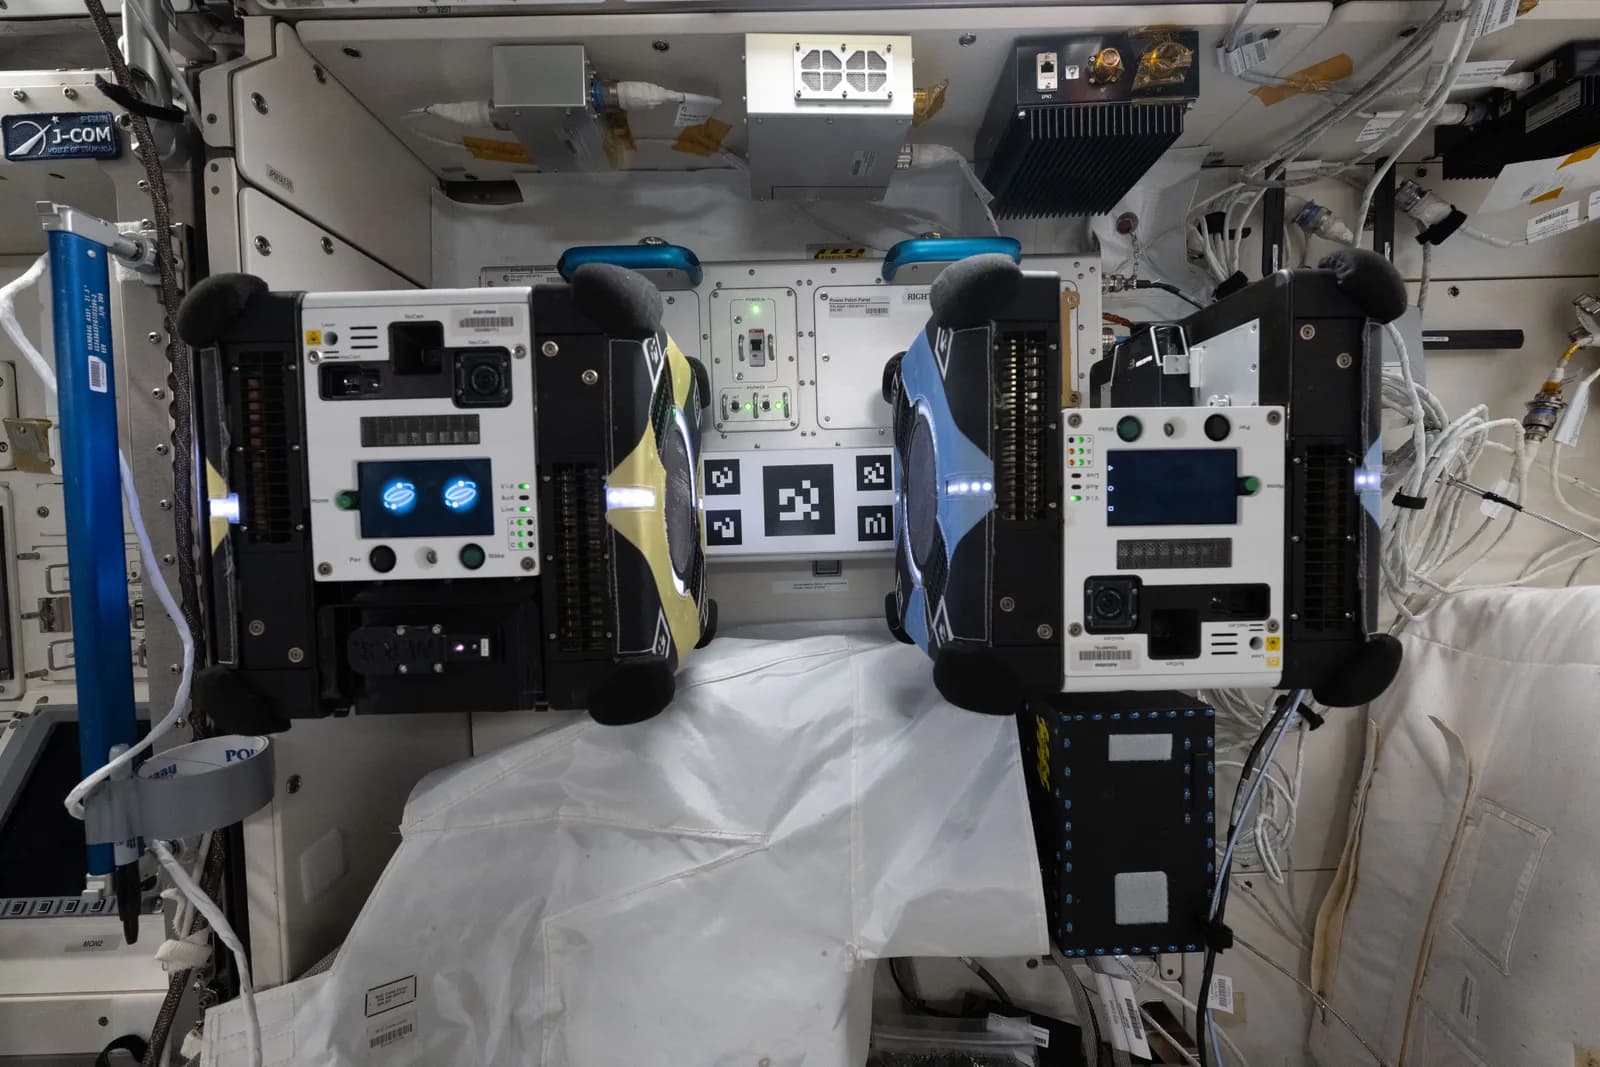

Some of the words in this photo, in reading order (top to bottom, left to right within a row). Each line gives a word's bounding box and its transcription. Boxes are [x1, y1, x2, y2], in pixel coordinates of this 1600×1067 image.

[53, 126, 112, 144] J-COM
[907, 293, 931, 301] RIGH
[224, 748, 255, 762] PO
